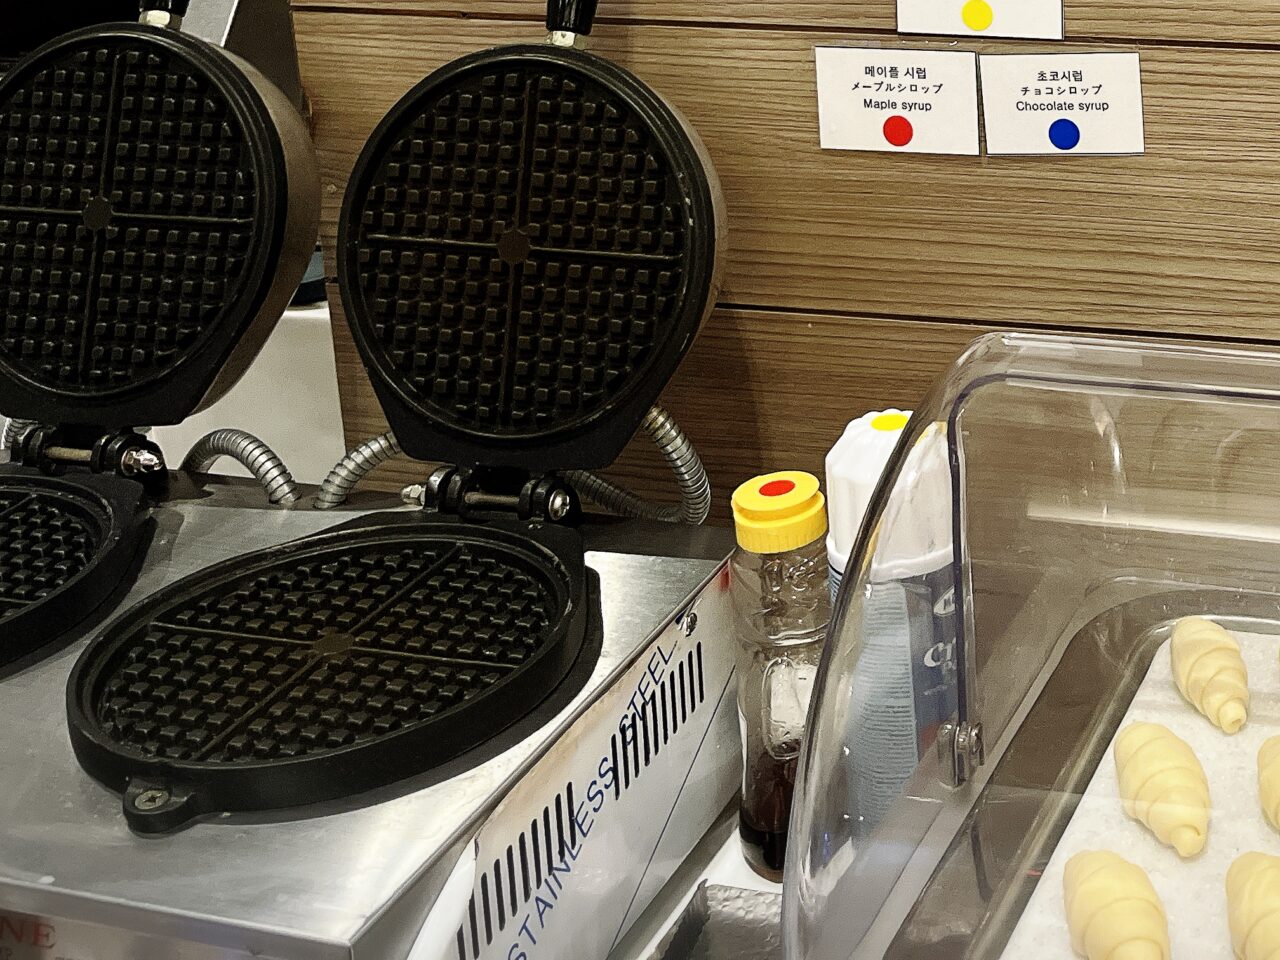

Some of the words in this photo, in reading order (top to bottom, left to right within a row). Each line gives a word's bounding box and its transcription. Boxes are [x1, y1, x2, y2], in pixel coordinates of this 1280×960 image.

[865, 66, 899, 78] 메이플
[904, 67, 926, 79] 시럽
[1037, 70, 1082, 82] 초코시럽
[852, 81, 943, 94] メープルシロップ
[1021, 84, 1102, 96] チョコシロップ
[864, 99, 897, 110] Maple
[902, 102, 931, 111] syrup
[1016, 101, 1074, 111] Chocolate
[1079, 102, 1109, 112] syrup
[619, 640, 678, 745] STEEL
